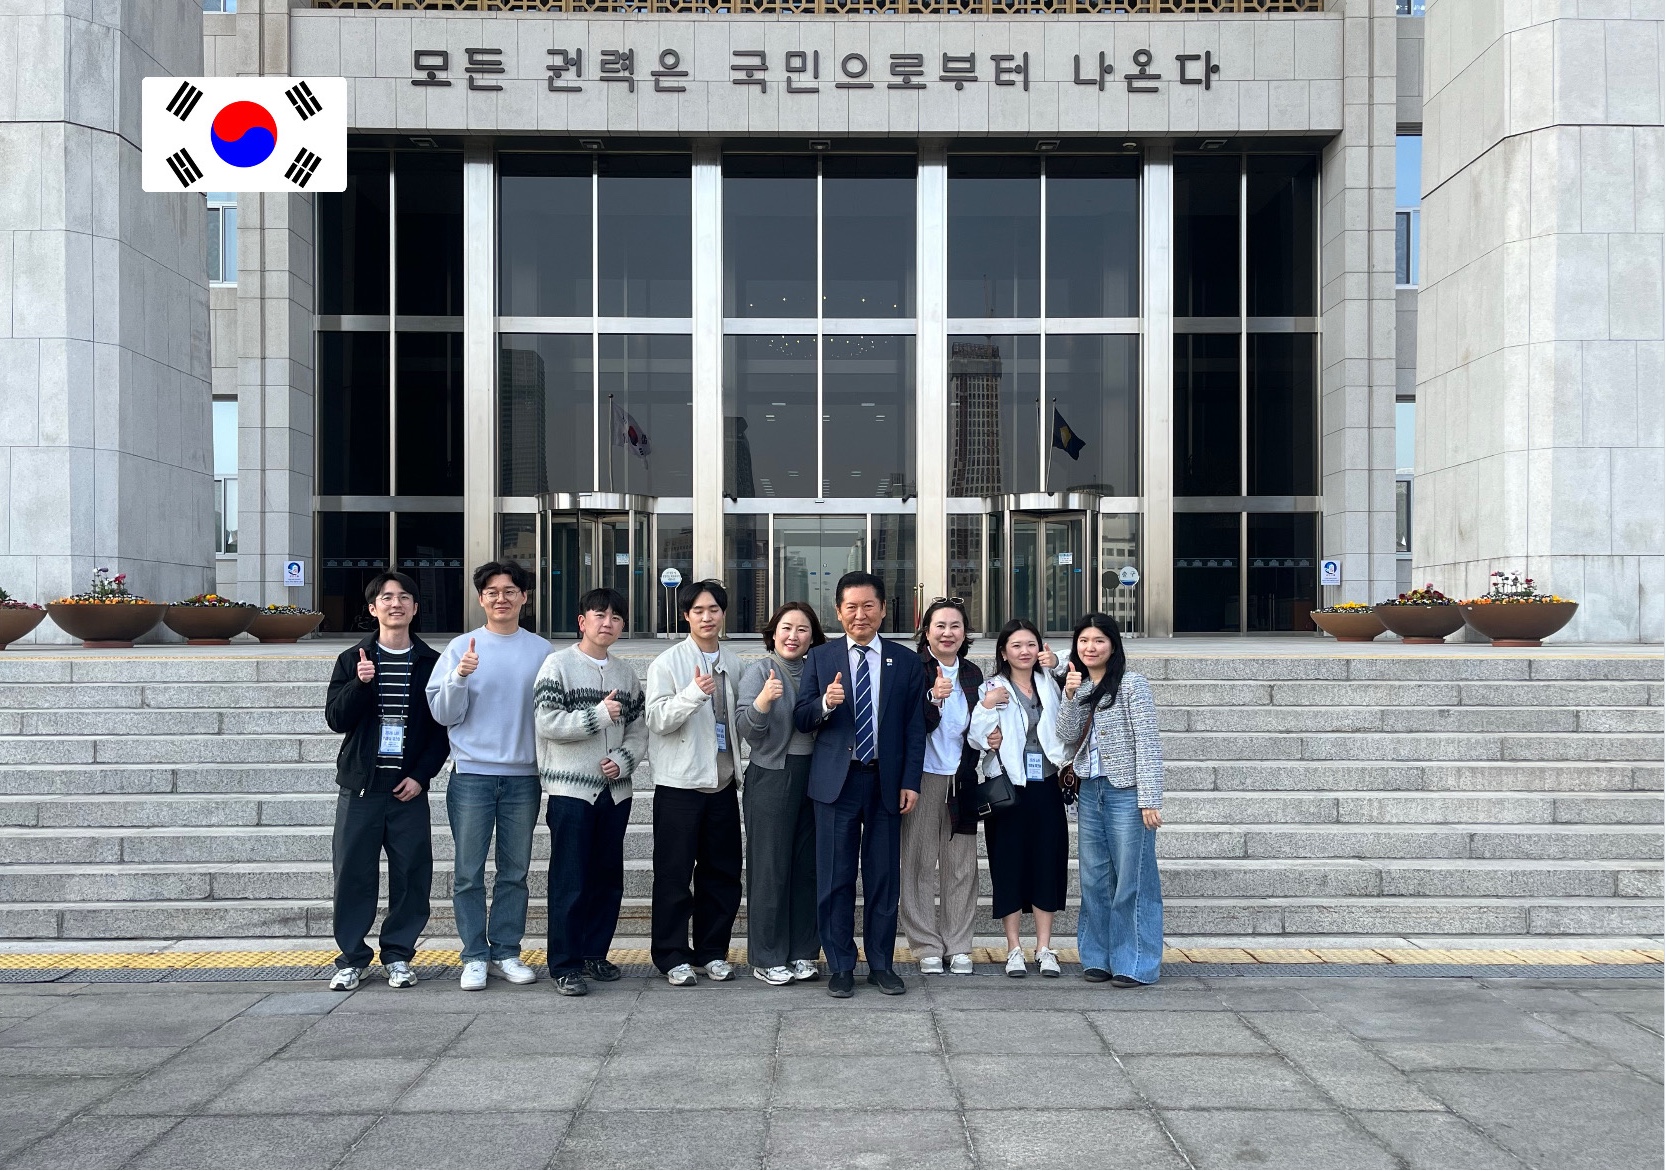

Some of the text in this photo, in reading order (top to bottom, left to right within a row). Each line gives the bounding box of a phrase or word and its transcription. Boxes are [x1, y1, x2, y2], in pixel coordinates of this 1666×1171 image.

[410, 47, 1221, 94] 모든 권력은 국민으로부터 나온다
